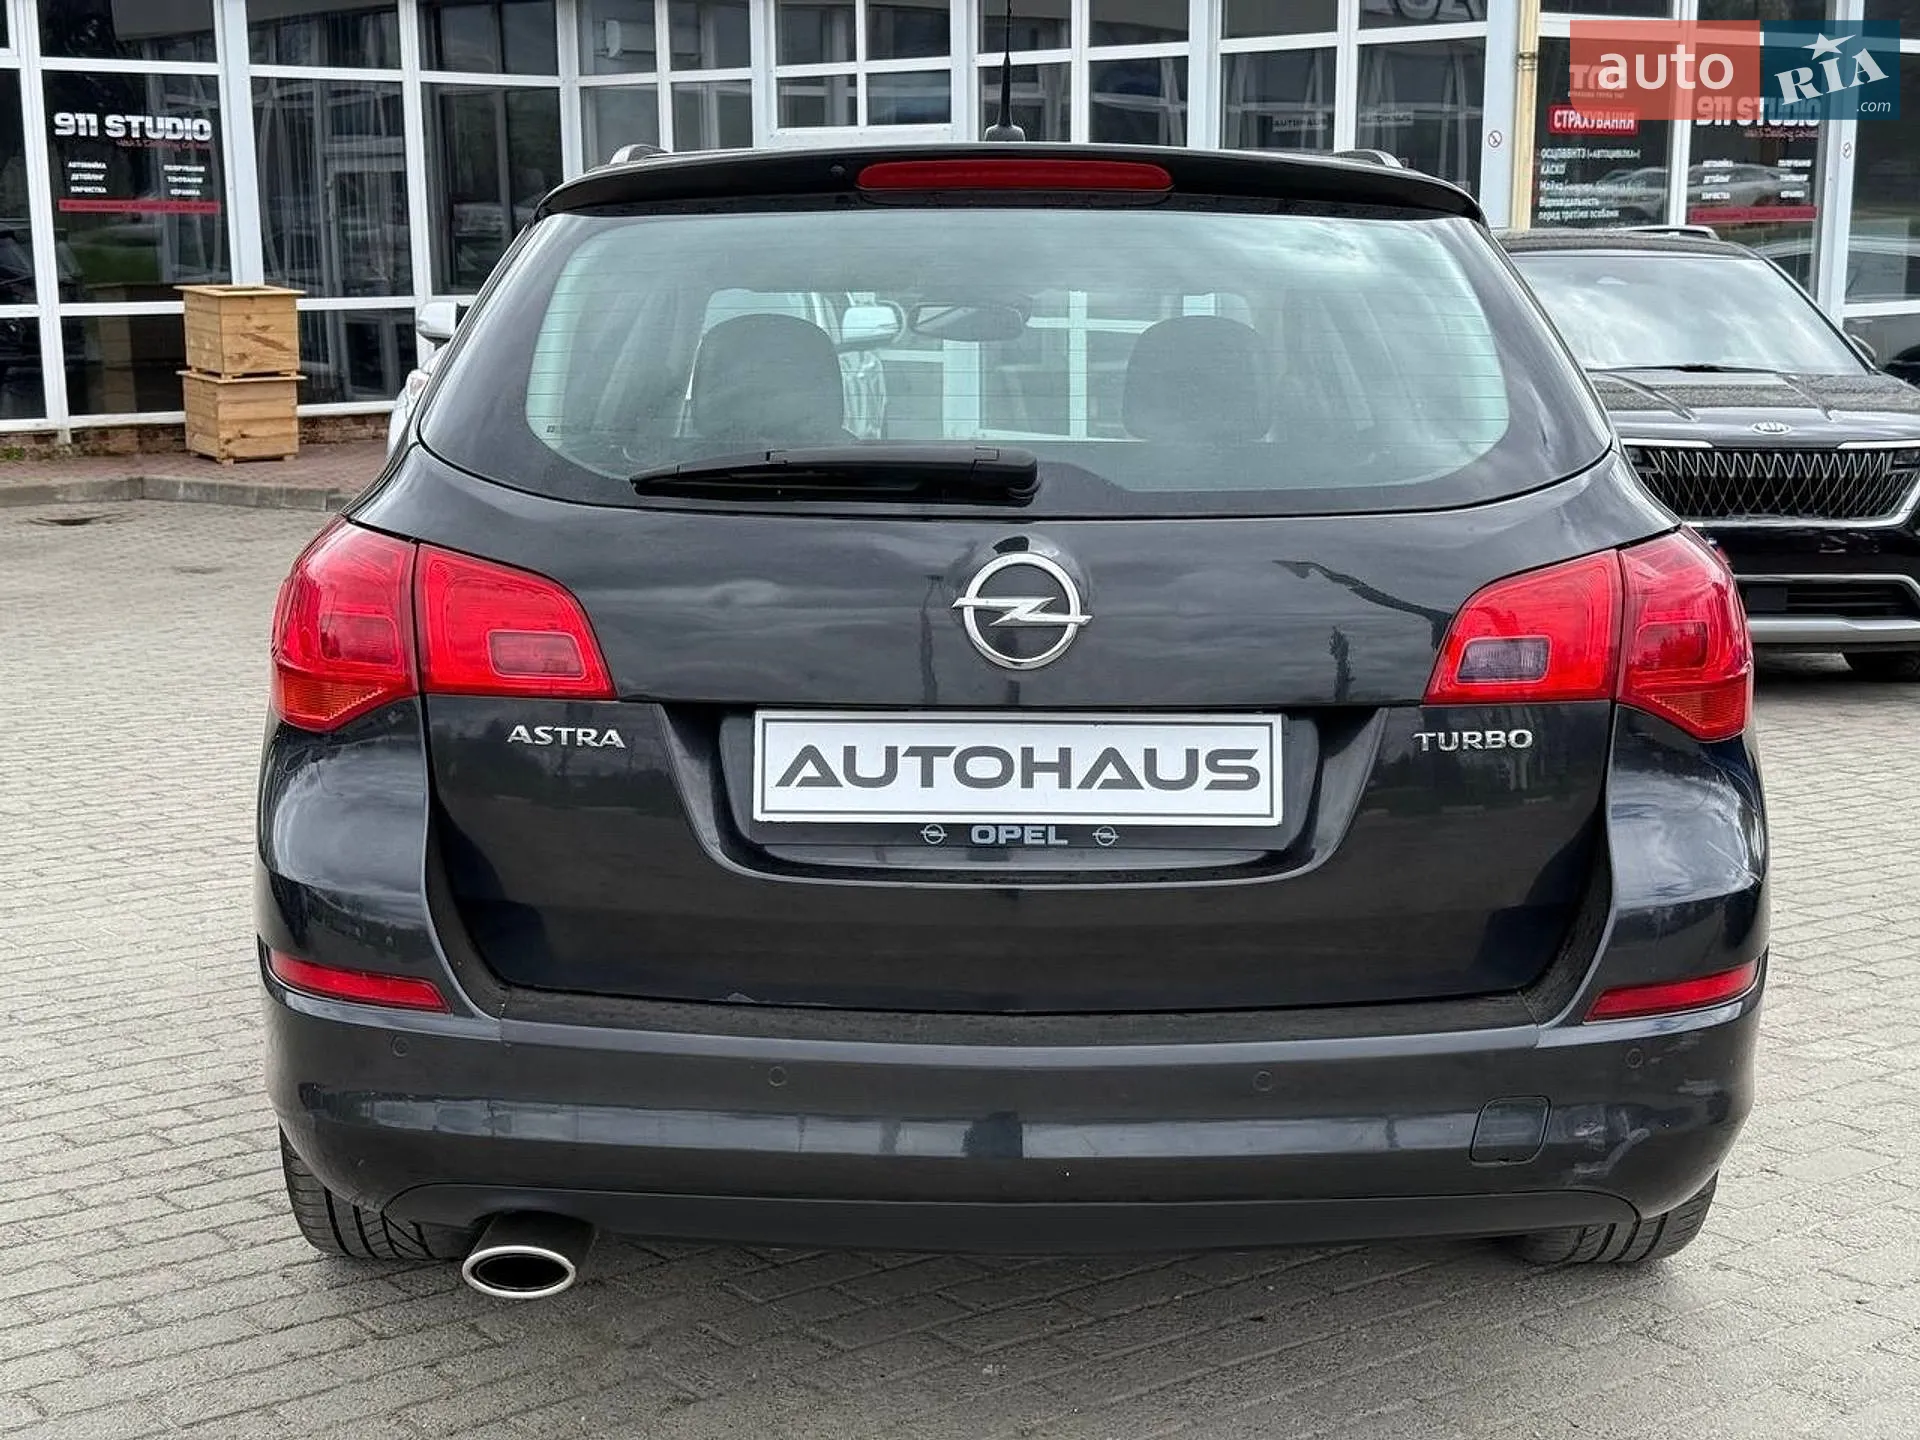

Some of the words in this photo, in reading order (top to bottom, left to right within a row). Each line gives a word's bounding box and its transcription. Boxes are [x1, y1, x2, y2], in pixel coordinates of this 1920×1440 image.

[1554, 109, 1636, 131] СТРАХУВАННЯ
[1696, 96, 1732, 126] 911
[1736, 96, 1820, 127] STUDIO
[54, 112, 99, 137] 911
[105, 114, 213, 141] STUDIO
[506, 724, 626, 749] ASTRA
[1414, 728, 1534, 752] TURBO
[775, 743, 1260, 791] AUTOHAUS
[970, 824, 1069, 845] OPEL
